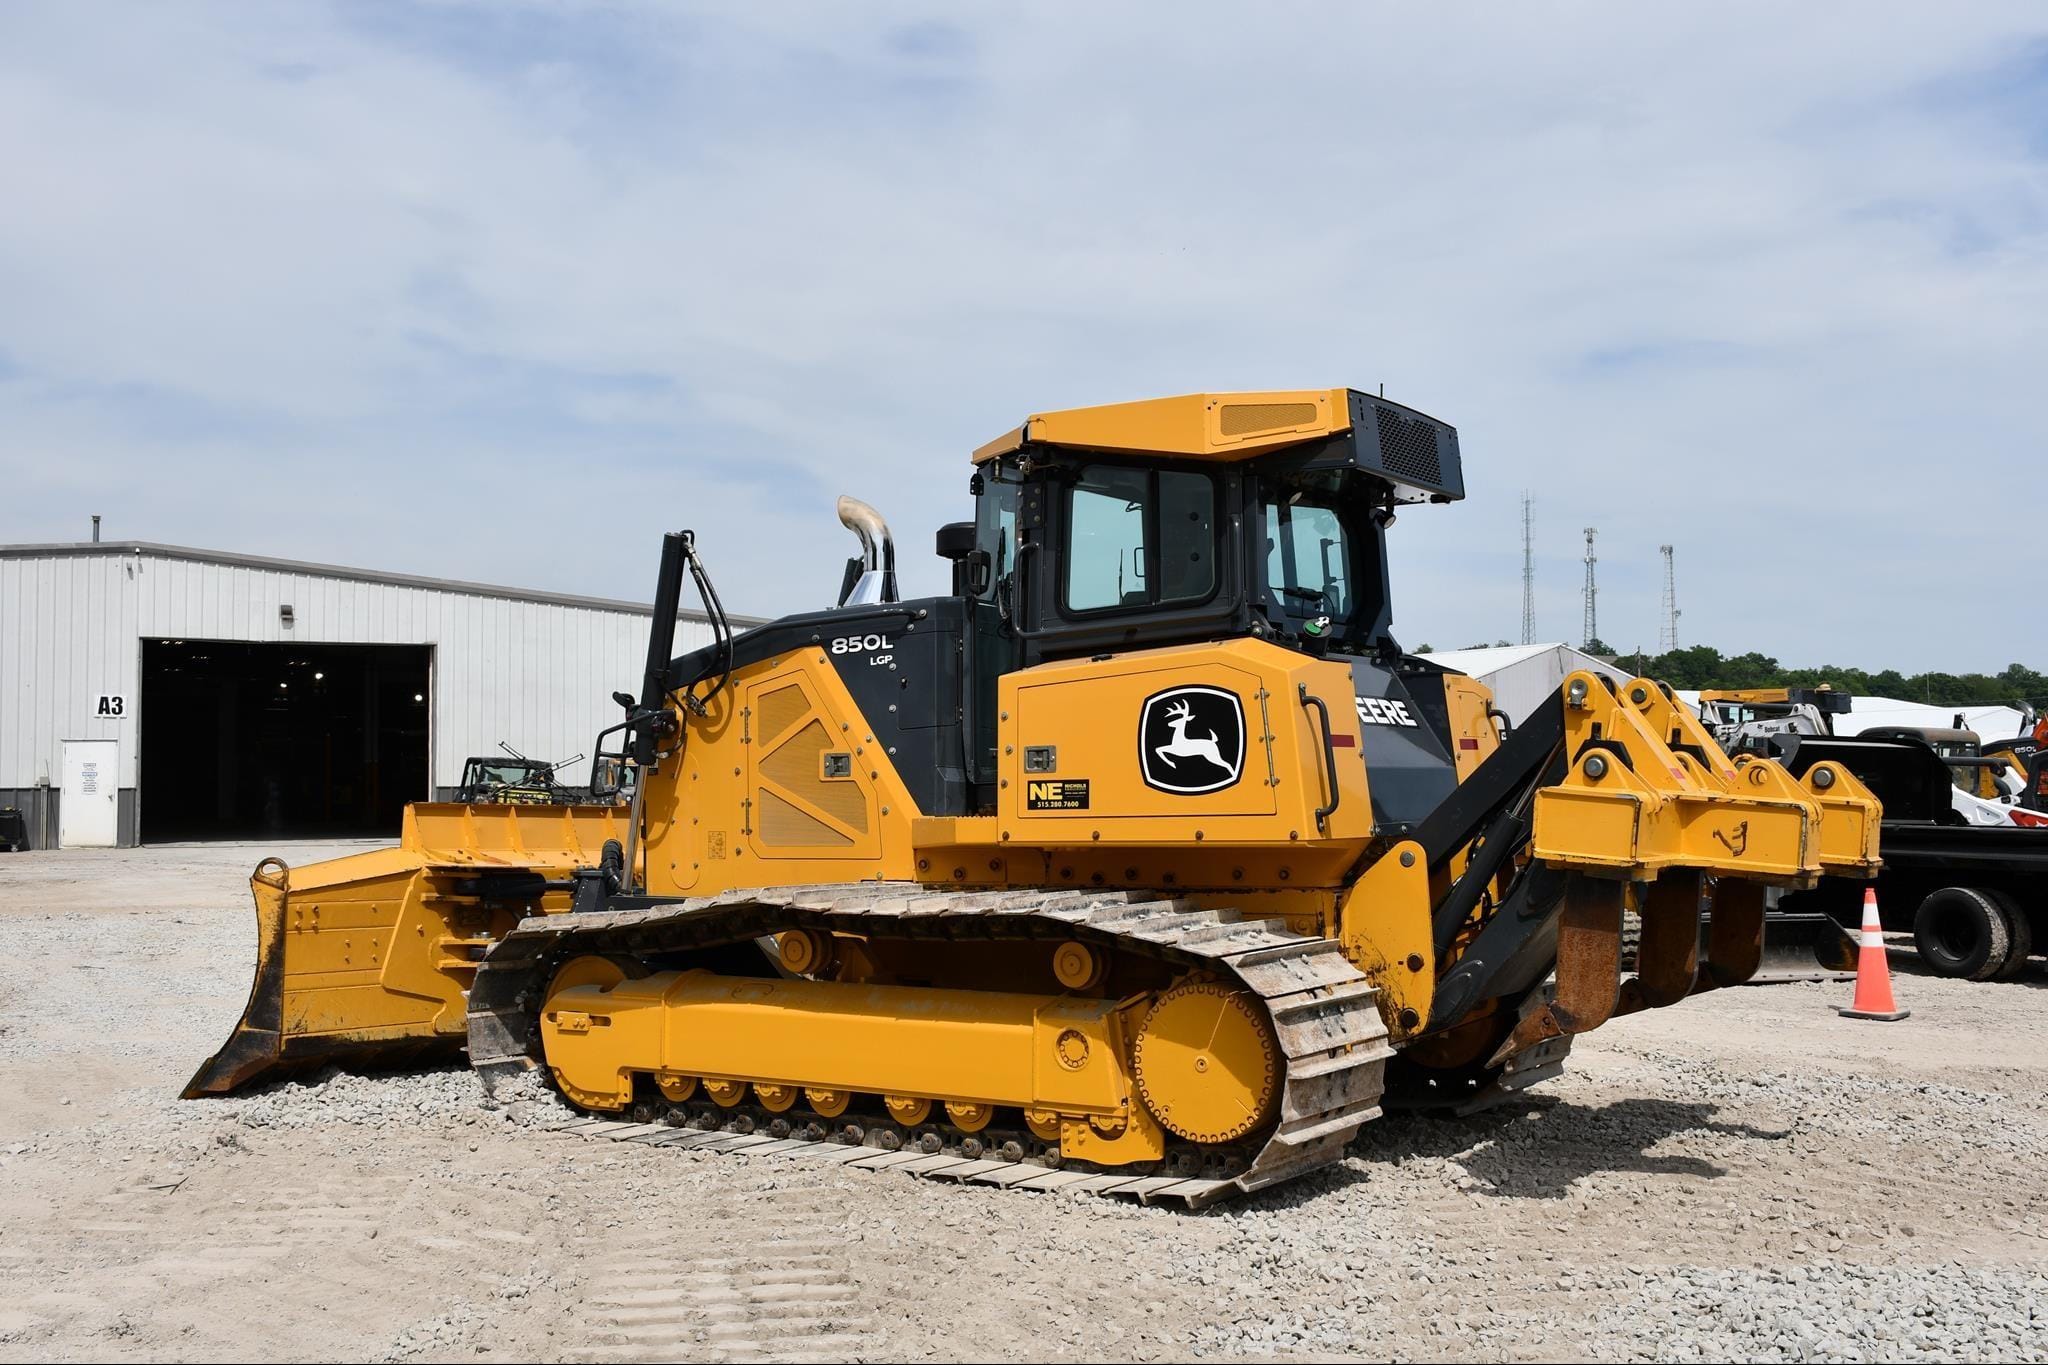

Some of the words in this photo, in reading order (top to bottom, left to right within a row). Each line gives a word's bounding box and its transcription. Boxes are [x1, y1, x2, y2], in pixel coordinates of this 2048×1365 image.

[831, 634, 894, 654] 850L
[870, 654, 893, 666] LGP
[98, 696, 123, 715] A3
[1030, 783, 1063, 800] NE
[1037, 800, 1079, 808] 515.280.7600
